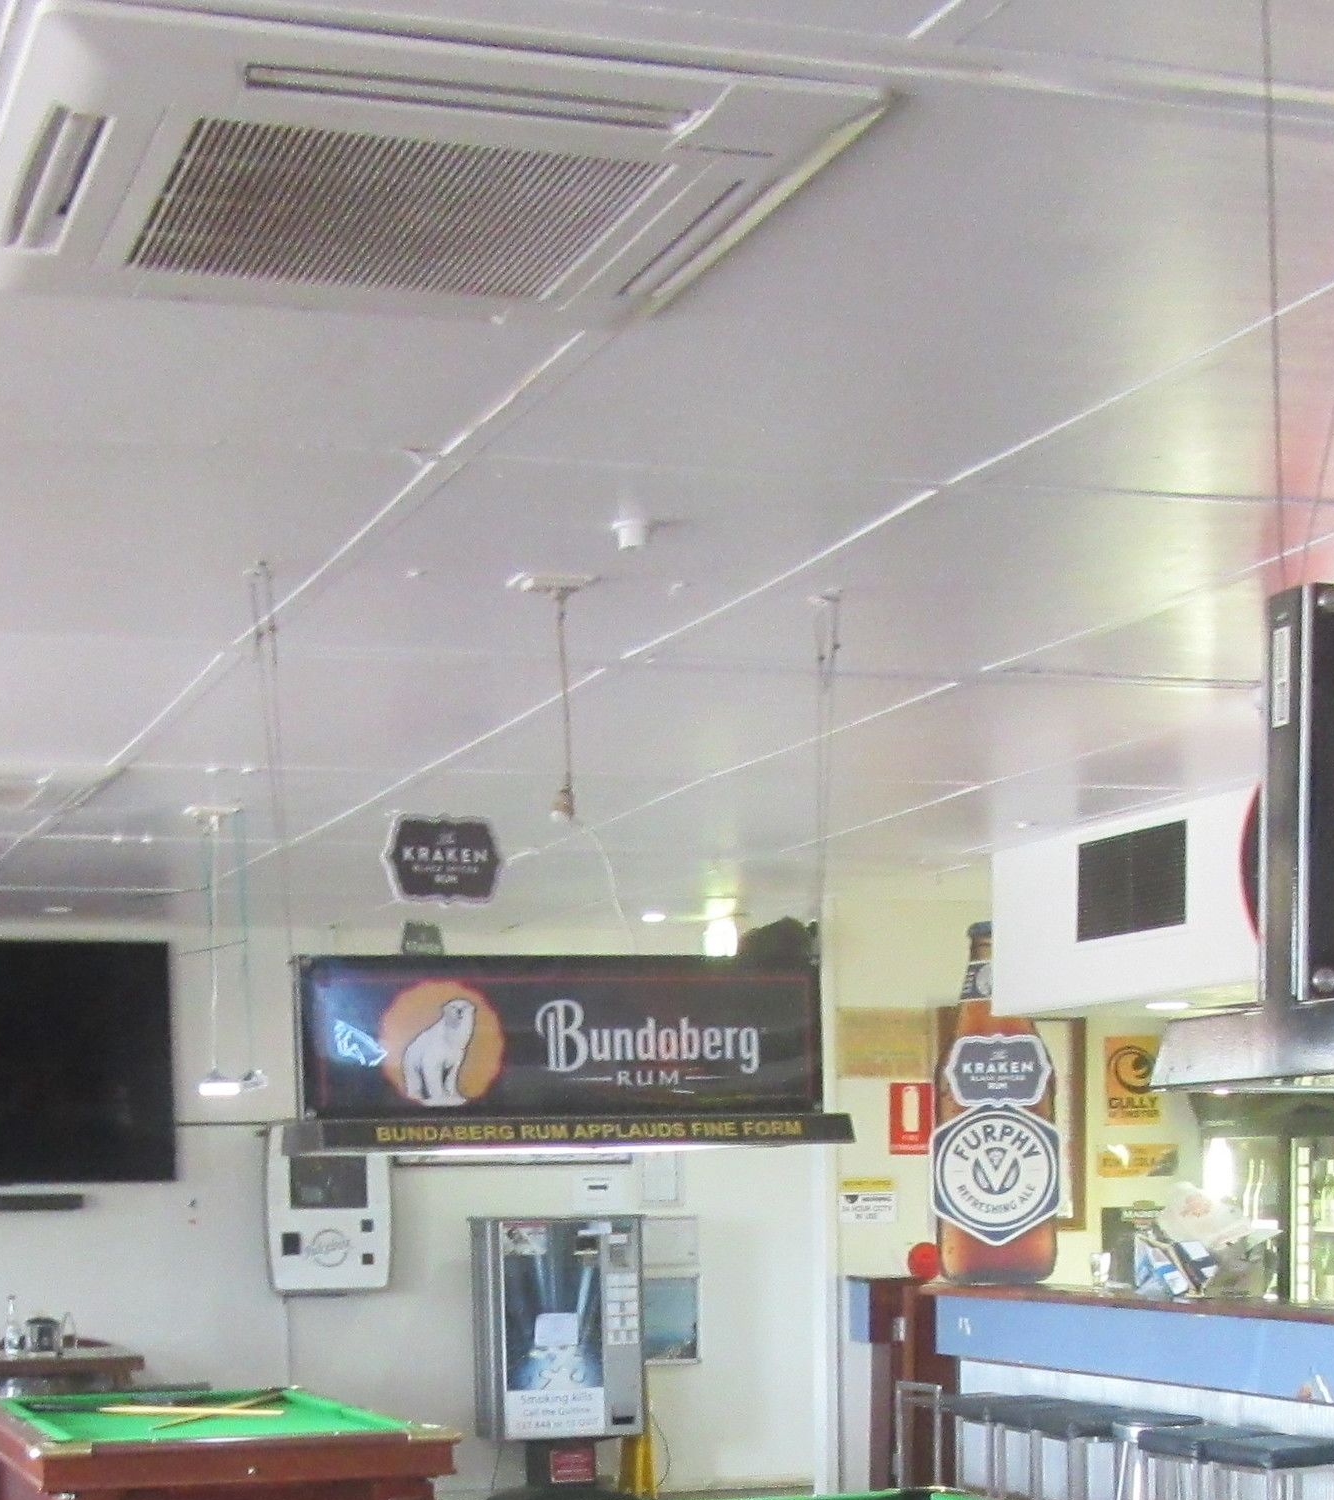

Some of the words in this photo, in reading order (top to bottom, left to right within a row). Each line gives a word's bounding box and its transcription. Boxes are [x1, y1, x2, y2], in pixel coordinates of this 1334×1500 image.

[401, 846, 488, 862] KRAKEN
[534, 999, 761, 1074] Bundaberg
[961, 1061, 1035, 1074] KRAKEN
[616, 1070, 680, 1088] RUM
[375, 1124, 516, 1142] BUNDABERG
[521, 1124, 568, 1140] RUM
[573, 1122, 687, 1139] APPLAUDS
[691, 1121, 738, 1137] FINE
[741, 1120, 804, 1136] FORM
[953, 1123, 1042, 1161] FURPHY
[958, 1185, 1017, 1213] REFRESHING
[1018, 1183, 1036, 1202] ALE
